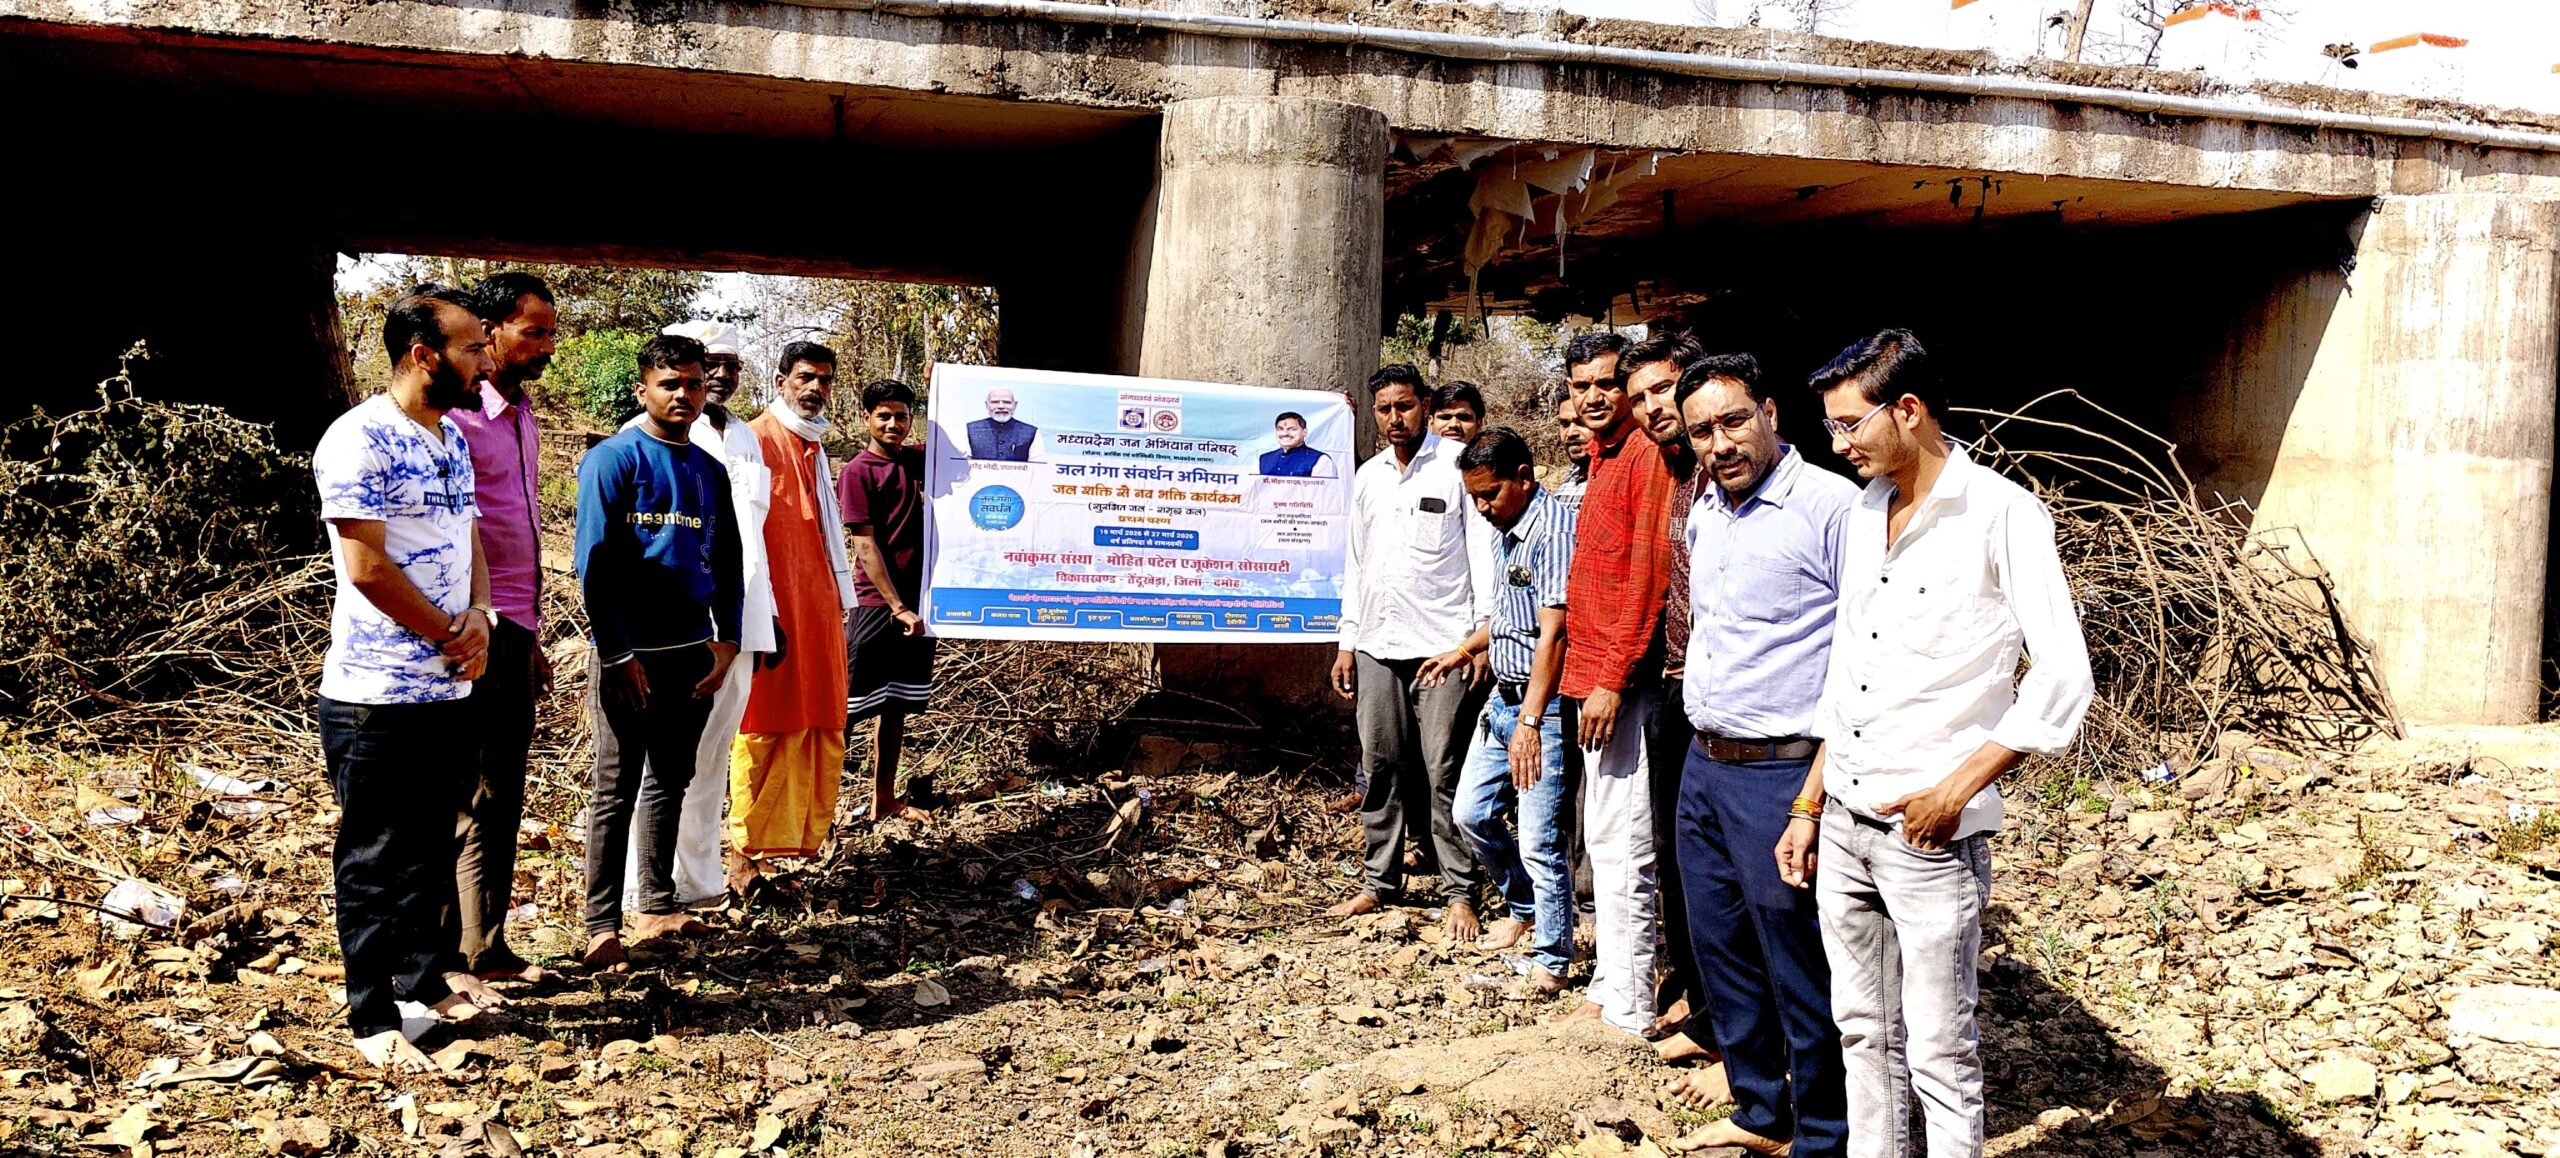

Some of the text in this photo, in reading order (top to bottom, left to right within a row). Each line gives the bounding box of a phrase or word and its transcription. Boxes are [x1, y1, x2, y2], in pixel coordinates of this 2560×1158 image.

[1057, 433, 1238, 457] मध्यप्रदेश जन अभियान परिषद्
[1056, 462, 1239, 485] जल गंगा संवर्धन अभियान
[1052, 484, 1077, 495] जल
[1081, 483, 1112, 496] शक्ति
[1134, 488, 1153, 499] नव
[1158, 487, 1187, 500] भक्ति
[1190, 489, 1241, 504] कार्यक्रम
[1129, 504, 1145, 512] जल
[1176, 532, 1194, 540] 2026
[1060, 551, 1093, 565] संस्था
[1106, 553, 1144, 567] मोहित
[1147, 554, 1177, 569] पटेल
[1180, 556, 1234, 573] एजूकेशन
[1238, 558, 1290, 573] सोसायटी
[1056, 571, 1116, 584] विकासखण्ड
[1174, 575, 1202, 587] जिला
[1213, 577, 1240, 588] दमोह
